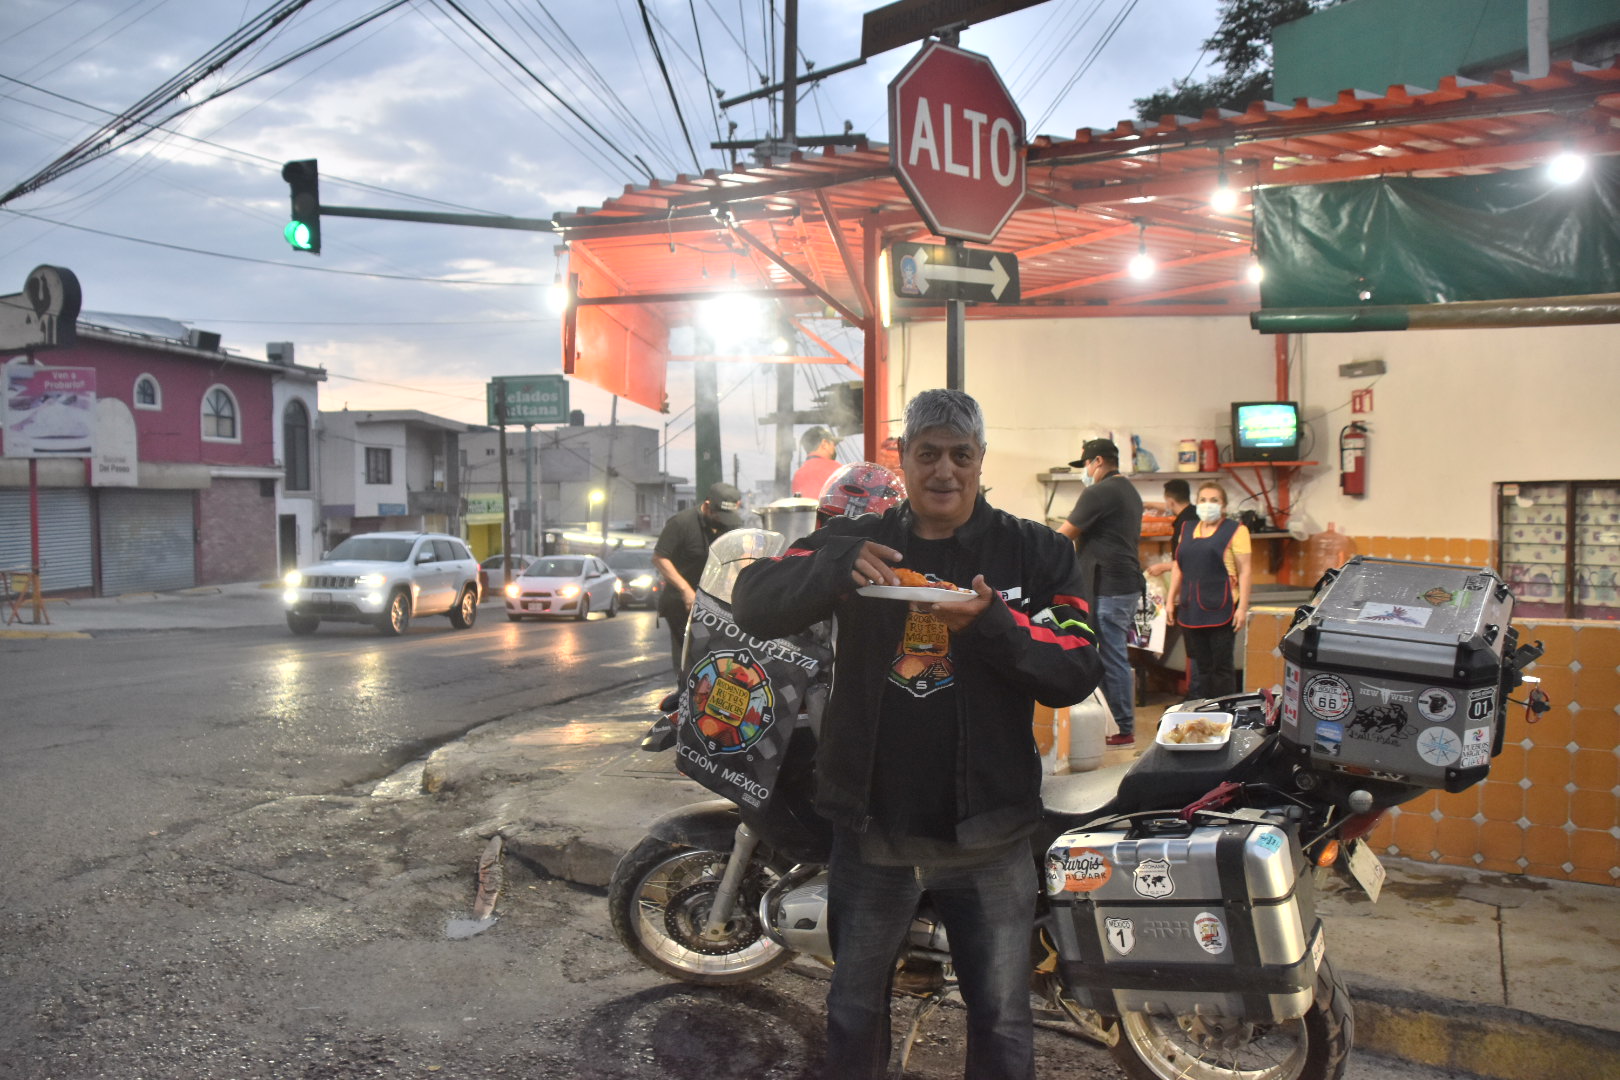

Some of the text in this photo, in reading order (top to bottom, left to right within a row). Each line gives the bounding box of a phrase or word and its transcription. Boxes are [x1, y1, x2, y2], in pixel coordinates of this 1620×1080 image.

[909, 97, 1016, 188] ALTO
[496, 390, 558, 403] elados
[916, 680, 928, 690] S
[1318, 697, 1337, 709] 66
[1359, 687, 1379, 697] NEW
[1391, 693, 1414, 703] WEST
[1474, 700, 1488, 717] 01
[721, 767, 769, 800] MÉXICO
[1116, 929, 1126, 948] 1
